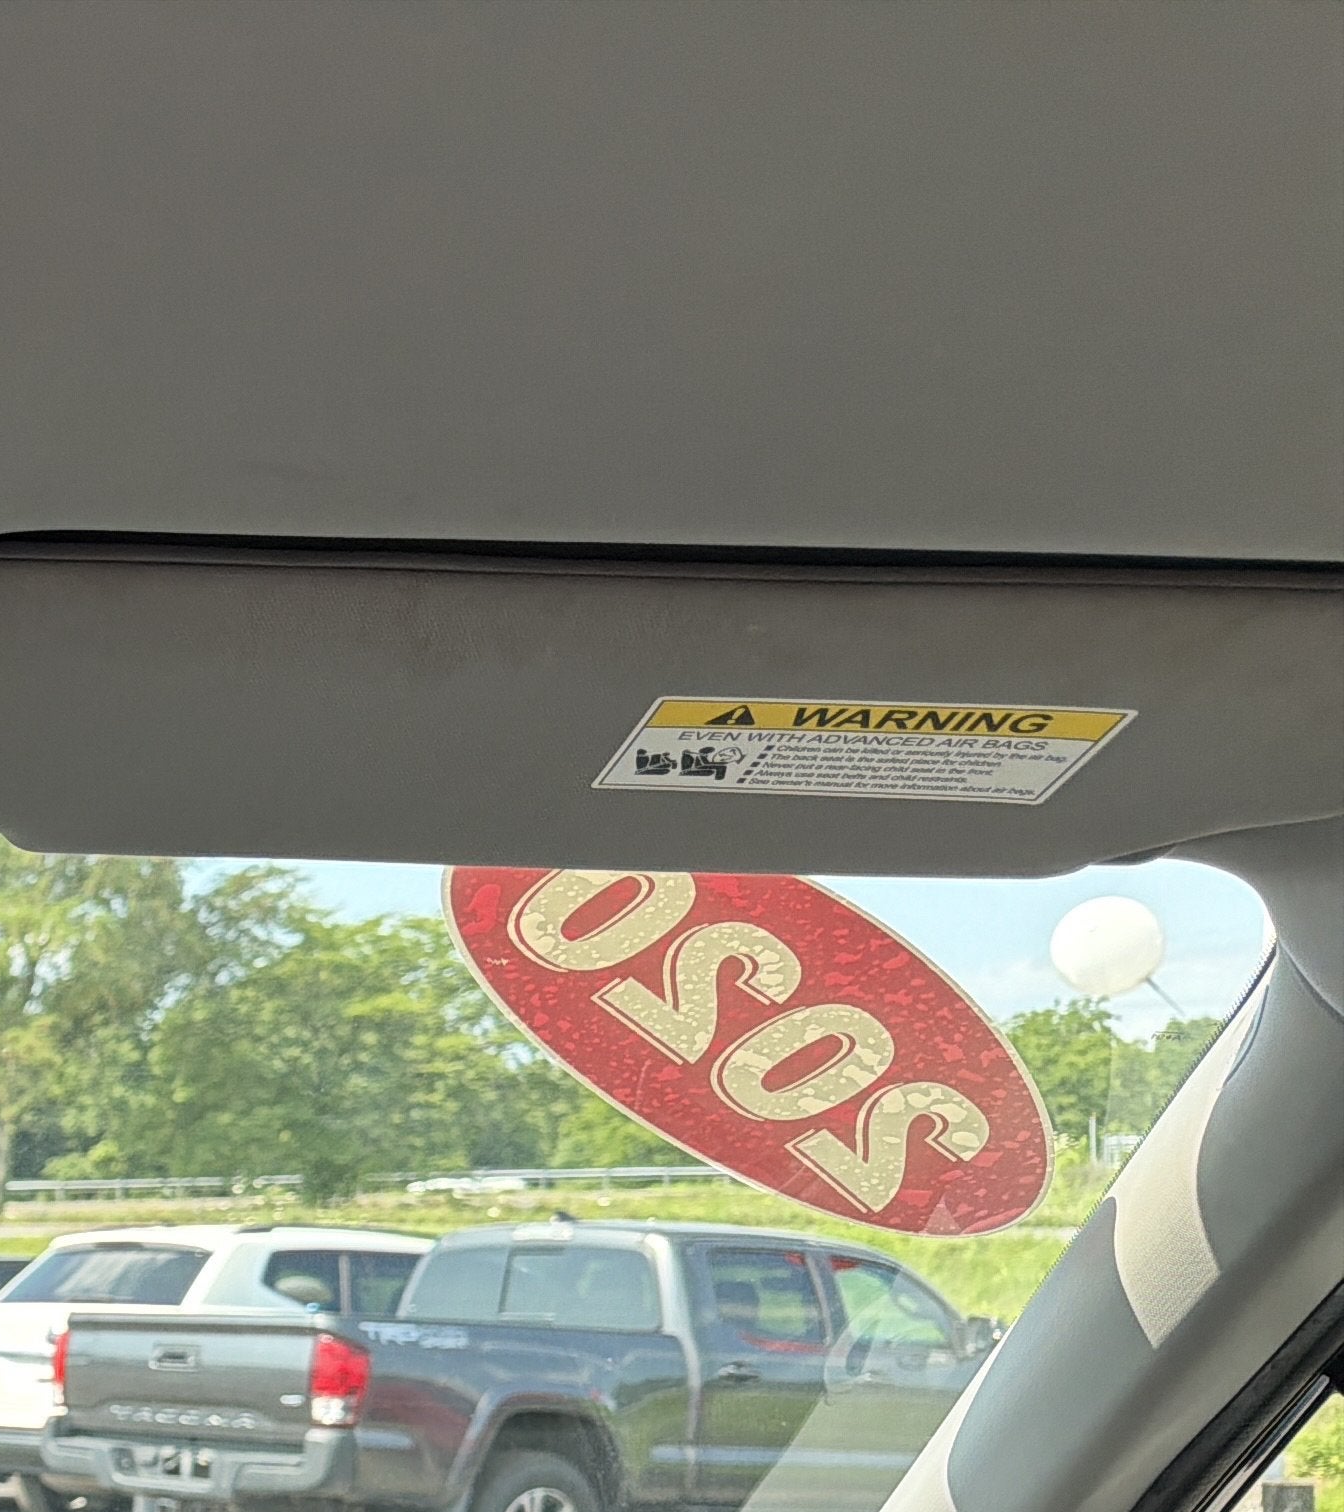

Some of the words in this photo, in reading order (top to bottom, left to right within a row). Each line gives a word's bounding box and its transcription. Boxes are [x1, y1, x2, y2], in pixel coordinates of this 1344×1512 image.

[792, 707, 1054, 734] WARNING
[678, 731, 742, 741] EVEN
[748, 733, 805, 743] WITH
[807, 734, 936, 748] ADVANCED
[942, 738, 979, 749] AIR
[982, 740, 1049, 751] BAGS
